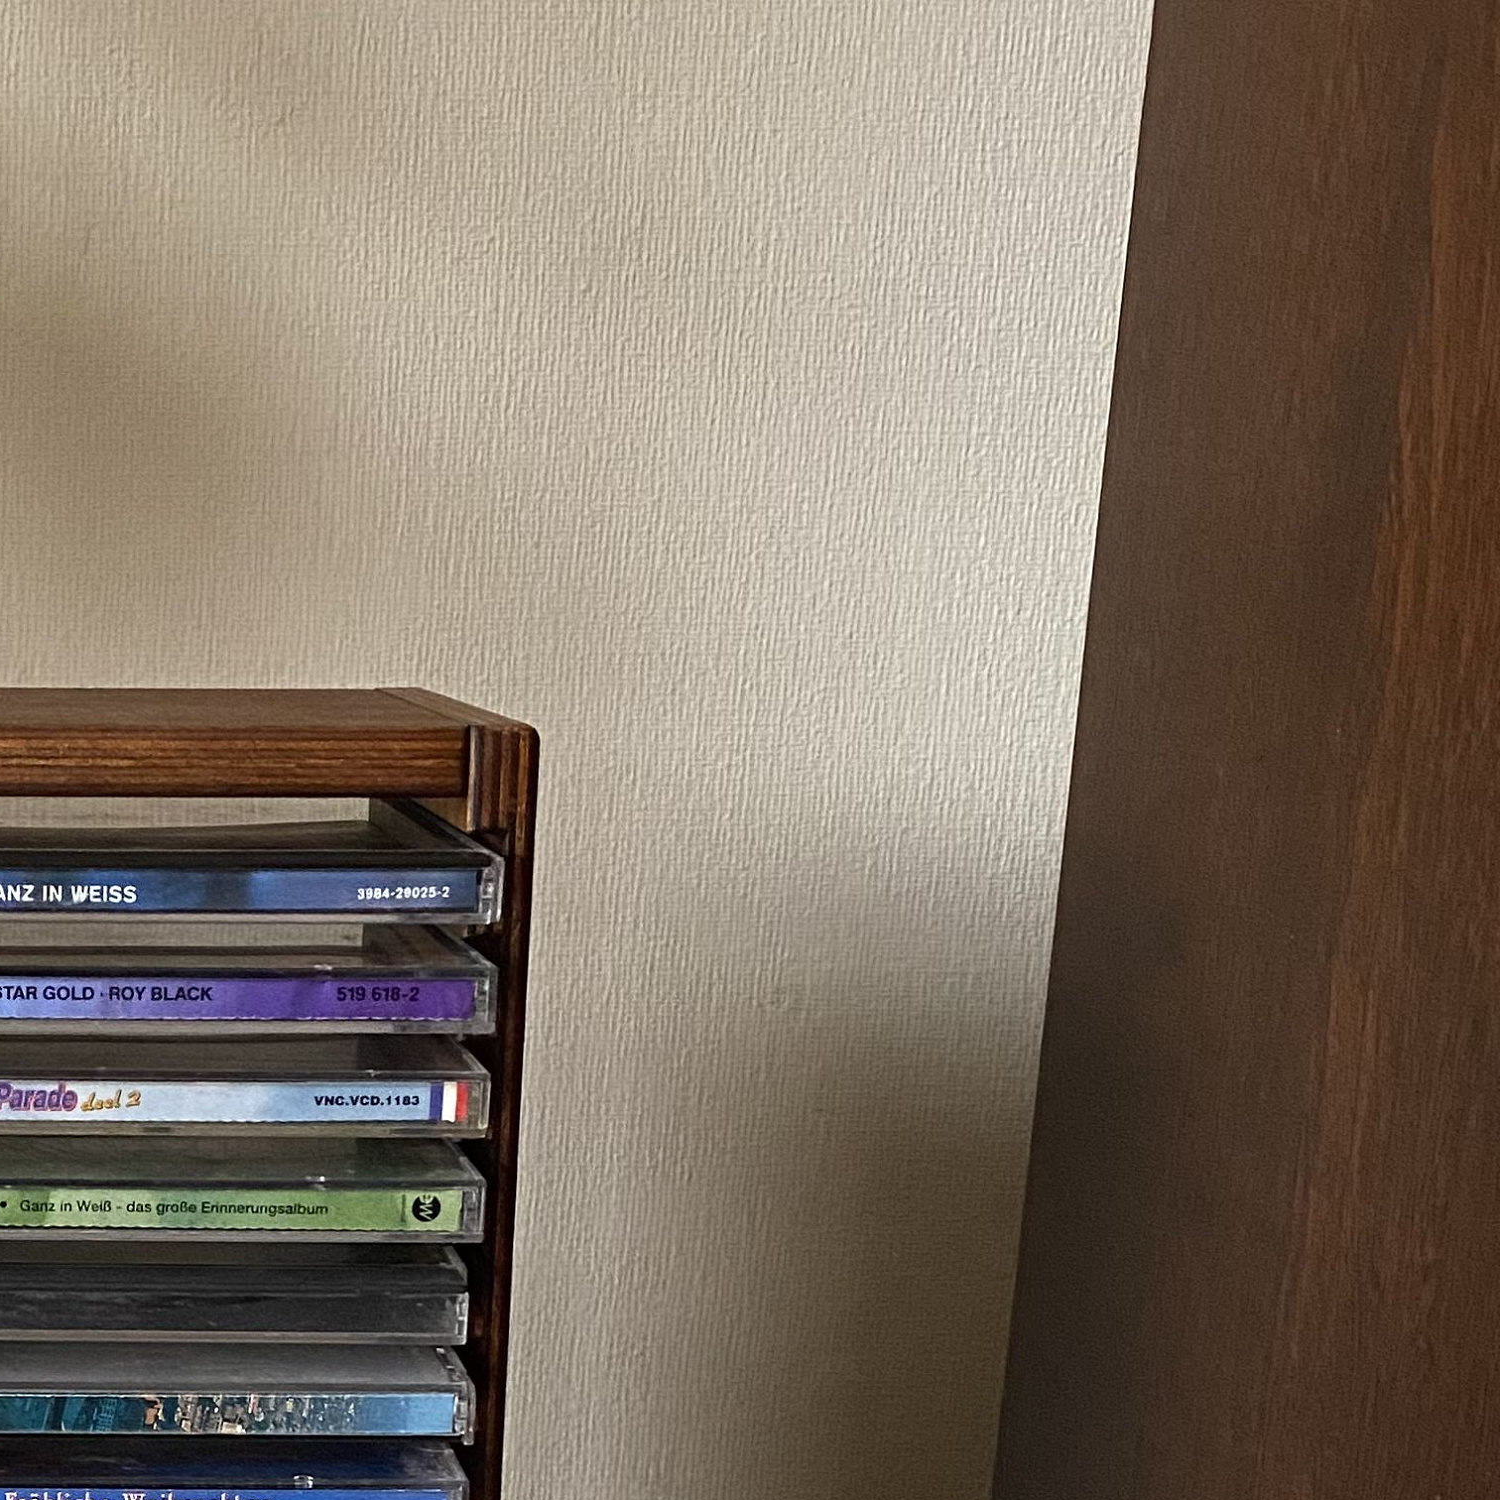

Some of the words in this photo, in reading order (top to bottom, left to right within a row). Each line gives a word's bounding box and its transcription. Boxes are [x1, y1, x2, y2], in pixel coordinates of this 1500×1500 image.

[43, 885, 63, 902] IN
[71, 885, 137, 903] WEISS
[42, 985, 94, 1000] GOLD
[109, 986, 147, 1001] ROY
[151, 986, 213, 1002] BLACK
[337, 986, 366, 1002] 519
[371, 986, 420, 1002] 618-2
[126, 1090, 142, 1107] 2
[314, 1095, 420, 1107] VNC.VCD.1183
[20, 1199, 56, 1213] Ganz
[61, 1199, 72, 1213] in
[77, 1199, 112, 1213] Weiß
[126, 1200, 152, 1214] das
[156, 1201, 197, 1218] große
[201, 1201, 328, 1218] Erinnerungsalbum
